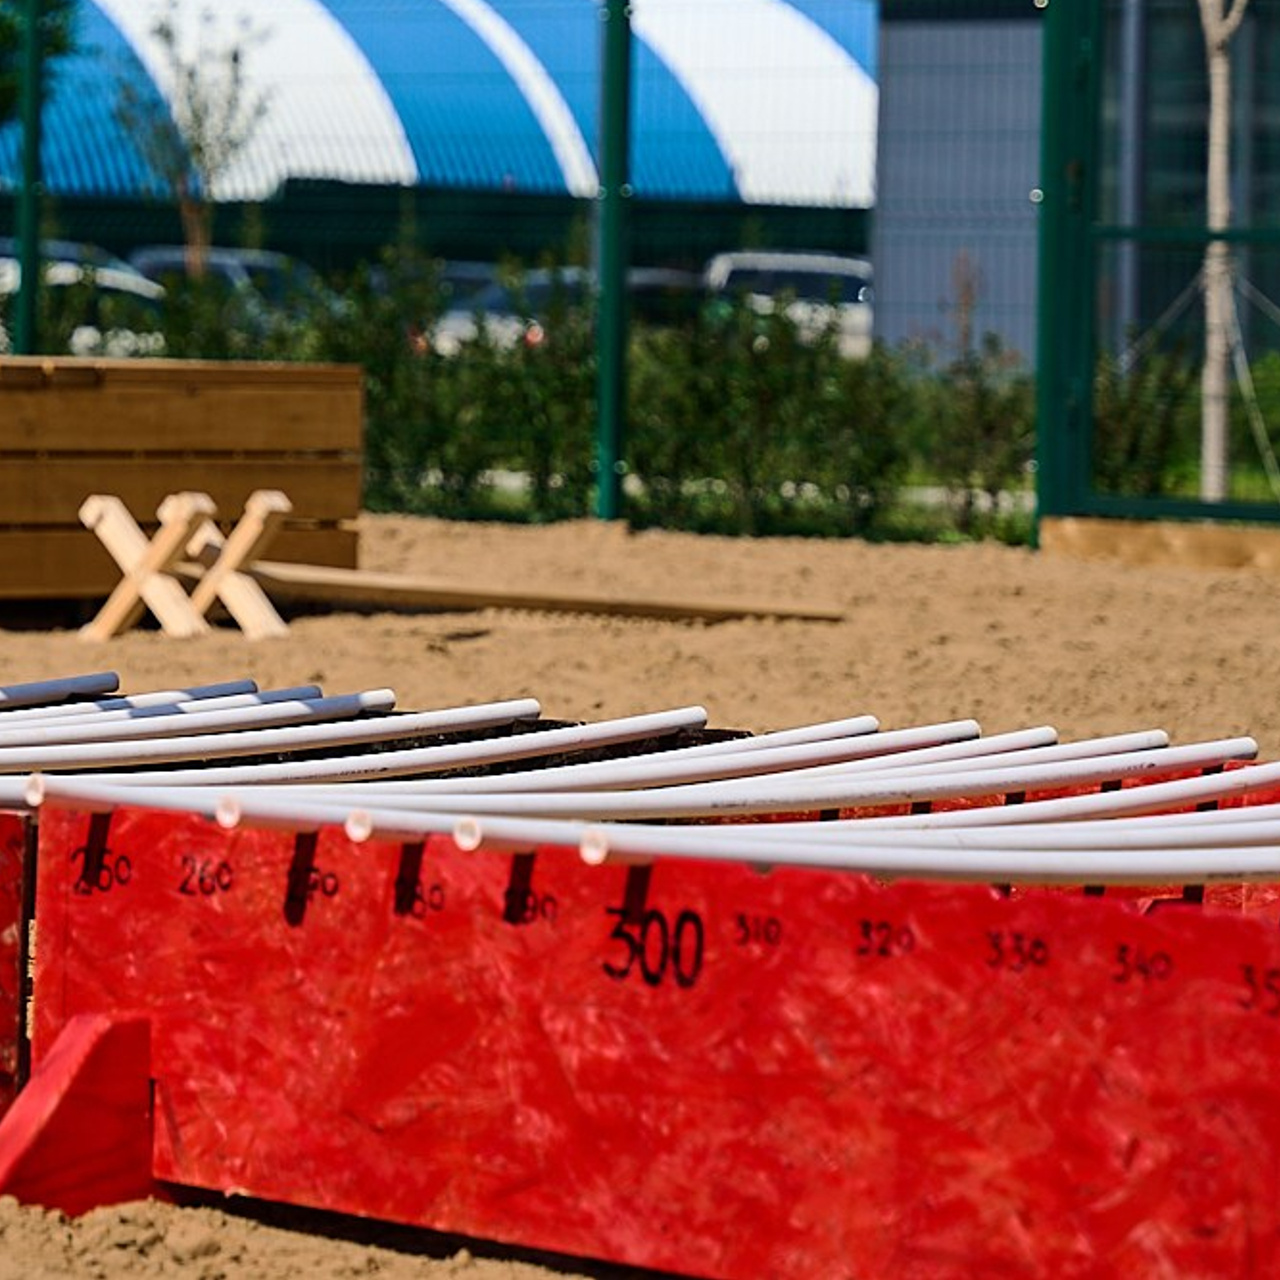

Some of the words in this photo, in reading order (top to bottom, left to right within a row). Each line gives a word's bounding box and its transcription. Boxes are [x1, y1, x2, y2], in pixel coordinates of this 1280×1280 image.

[179, 854, 234, 896] 260
[602, 906, 705, 989] 300
[734, 912, 783, 948] 310
[856, 918, 915, 958] 320
[986, 929, 1049, 973] 330
